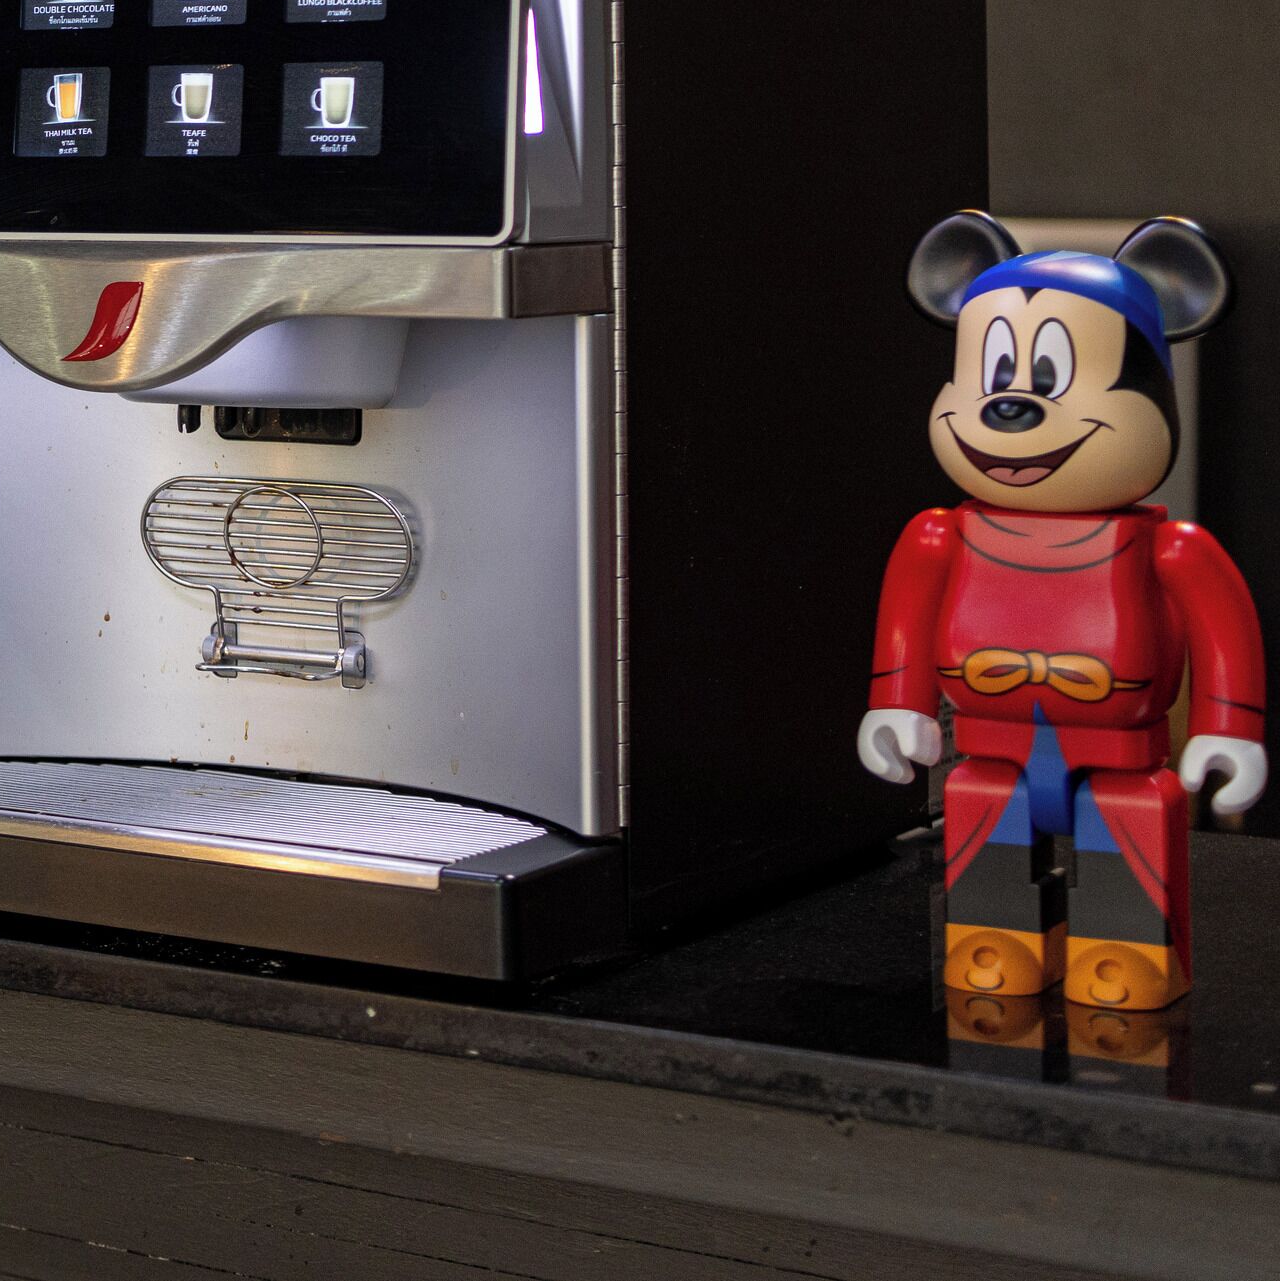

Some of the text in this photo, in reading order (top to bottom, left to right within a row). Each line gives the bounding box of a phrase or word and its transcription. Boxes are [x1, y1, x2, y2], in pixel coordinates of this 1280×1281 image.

[33, 4, 115, 14] DOUBLE CHOCOLATE
[182, 5, 228, 14] AMERICANO
[44, 127, 93, 138] THAI MILK TEA
[181, 129, 207, 137] TEAFE
[310, 135, 356, 143] CHOCO TEA
